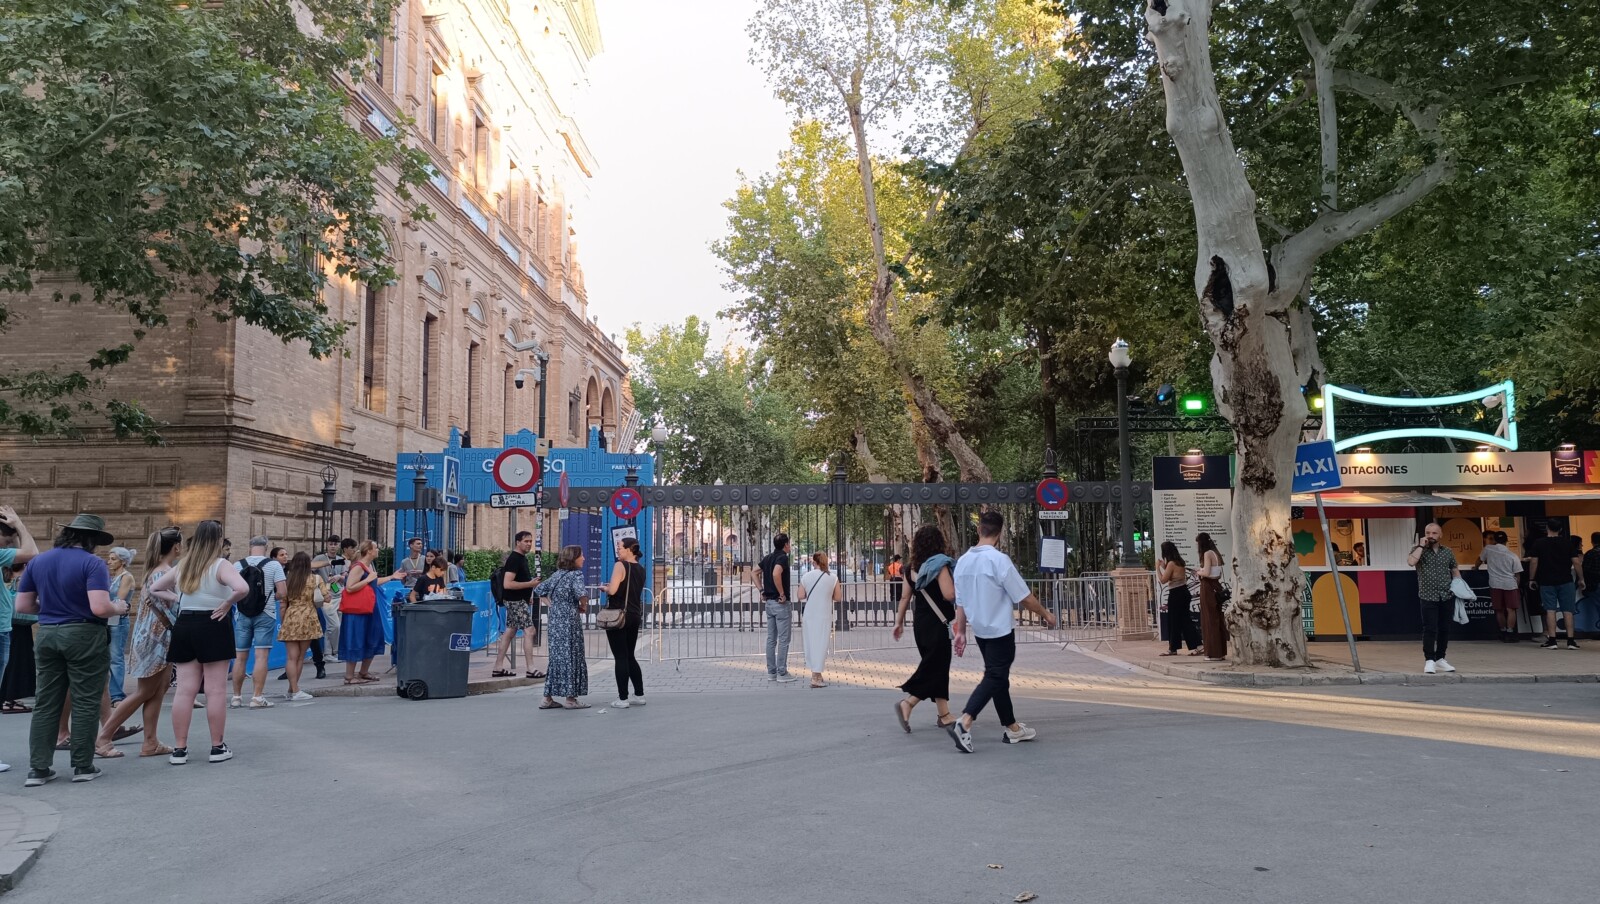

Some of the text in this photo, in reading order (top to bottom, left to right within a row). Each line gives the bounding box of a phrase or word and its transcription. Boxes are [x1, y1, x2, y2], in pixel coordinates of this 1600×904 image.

[1293, 457, 1335, 477] TAXI
[1340, 465, 1408, 475] DITACIONES
[1456, 464, 1515, 475] TAQUILLA
[1448, 530, 1465, 542] jun
